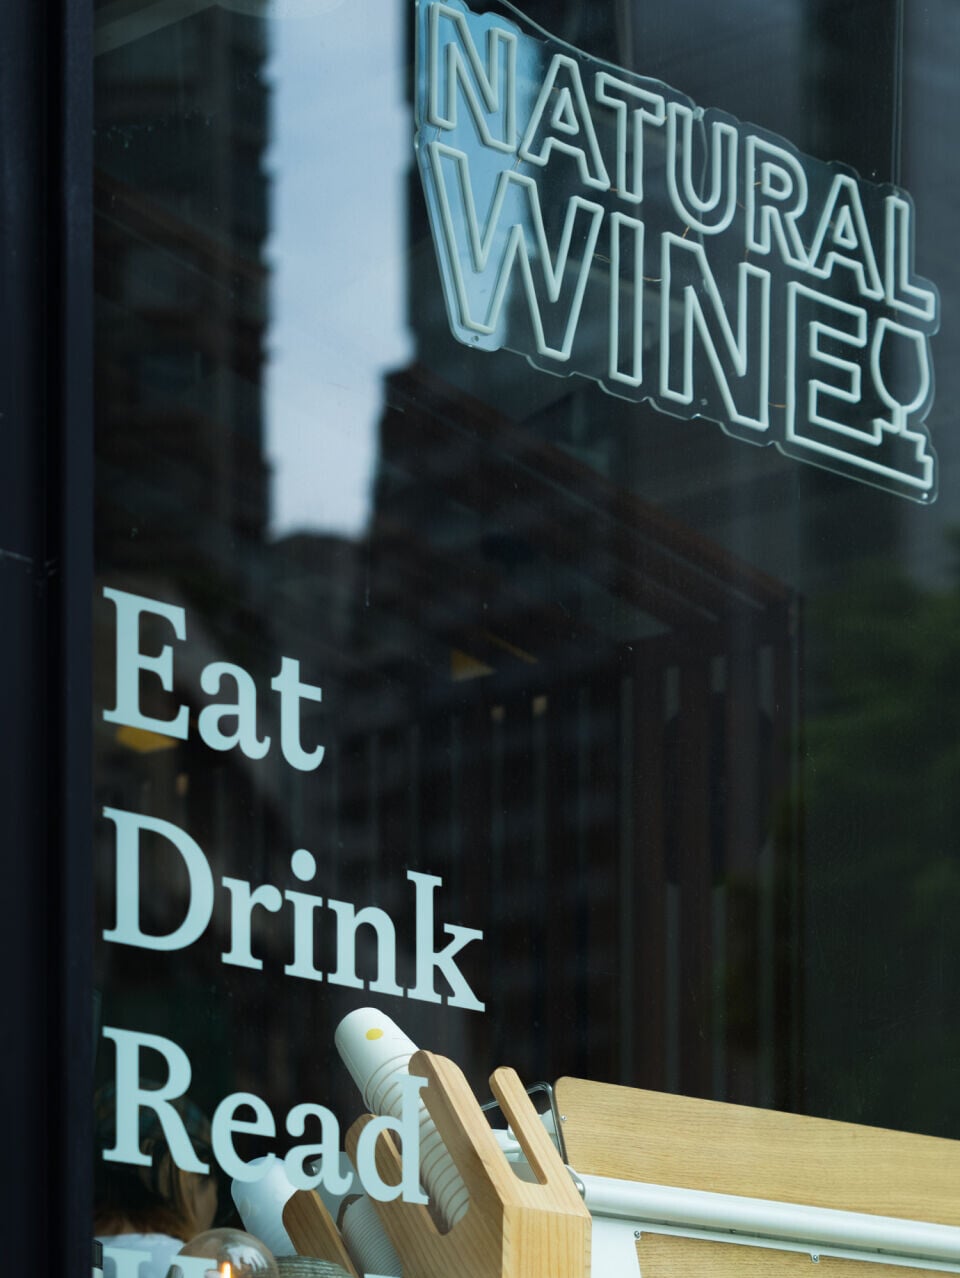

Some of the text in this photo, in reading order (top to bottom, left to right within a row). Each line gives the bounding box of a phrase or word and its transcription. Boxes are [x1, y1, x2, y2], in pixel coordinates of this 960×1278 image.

[428, 3, 936, 321] NATURAL
[428, 141, 933, 488] WINE
[102, 586, 325, 772] Eat
[102, 806, 486, 1013] Drink
[102, 1025, 430, 1205] Read
